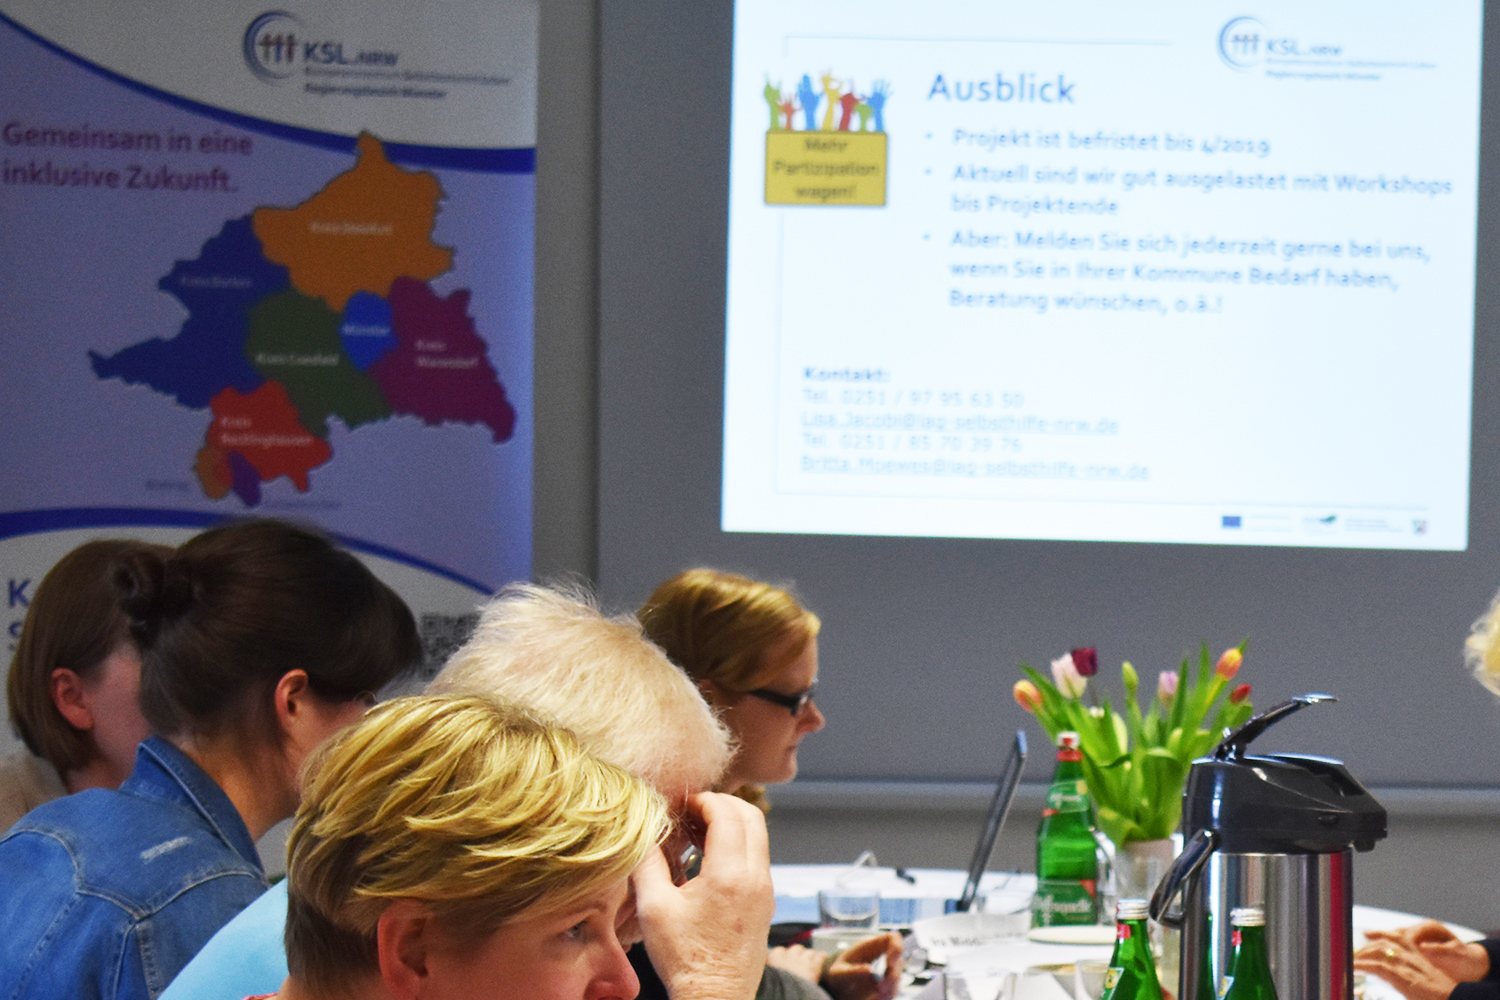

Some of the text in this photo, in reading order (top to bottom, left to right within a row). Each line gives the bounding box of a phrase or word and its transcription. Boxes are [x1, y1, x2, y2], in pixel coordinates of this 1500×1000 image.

[928, 72, 1076, 103] Ausblick
[2, 122, 254, 155] Gemeinsam in eine
[804, 138, 848, 153] Mehr
[953, 128, 1272, 158] Projekt ist befristet bis 4/2019
[2, 161, 239, 194] inklusive Zukunft.
[953, 165, 1454, 198] Aktuell sind wir gut ausgelastet mit Workshops
[952, 194, 1118, 218] bis Projektende
[950, 230, 1431, 265] Aber: Melden Sie sich jederzeit gerne bei uns,
[949, 260, 1399, 293] wenn Sie in Ihrer Kommune Bedarf haben,
[949, 289, 1049, 315] Beratung
[1054, 290, 1168, 316] wünschen,
[802, 366, 891, 383] Kontakt:
